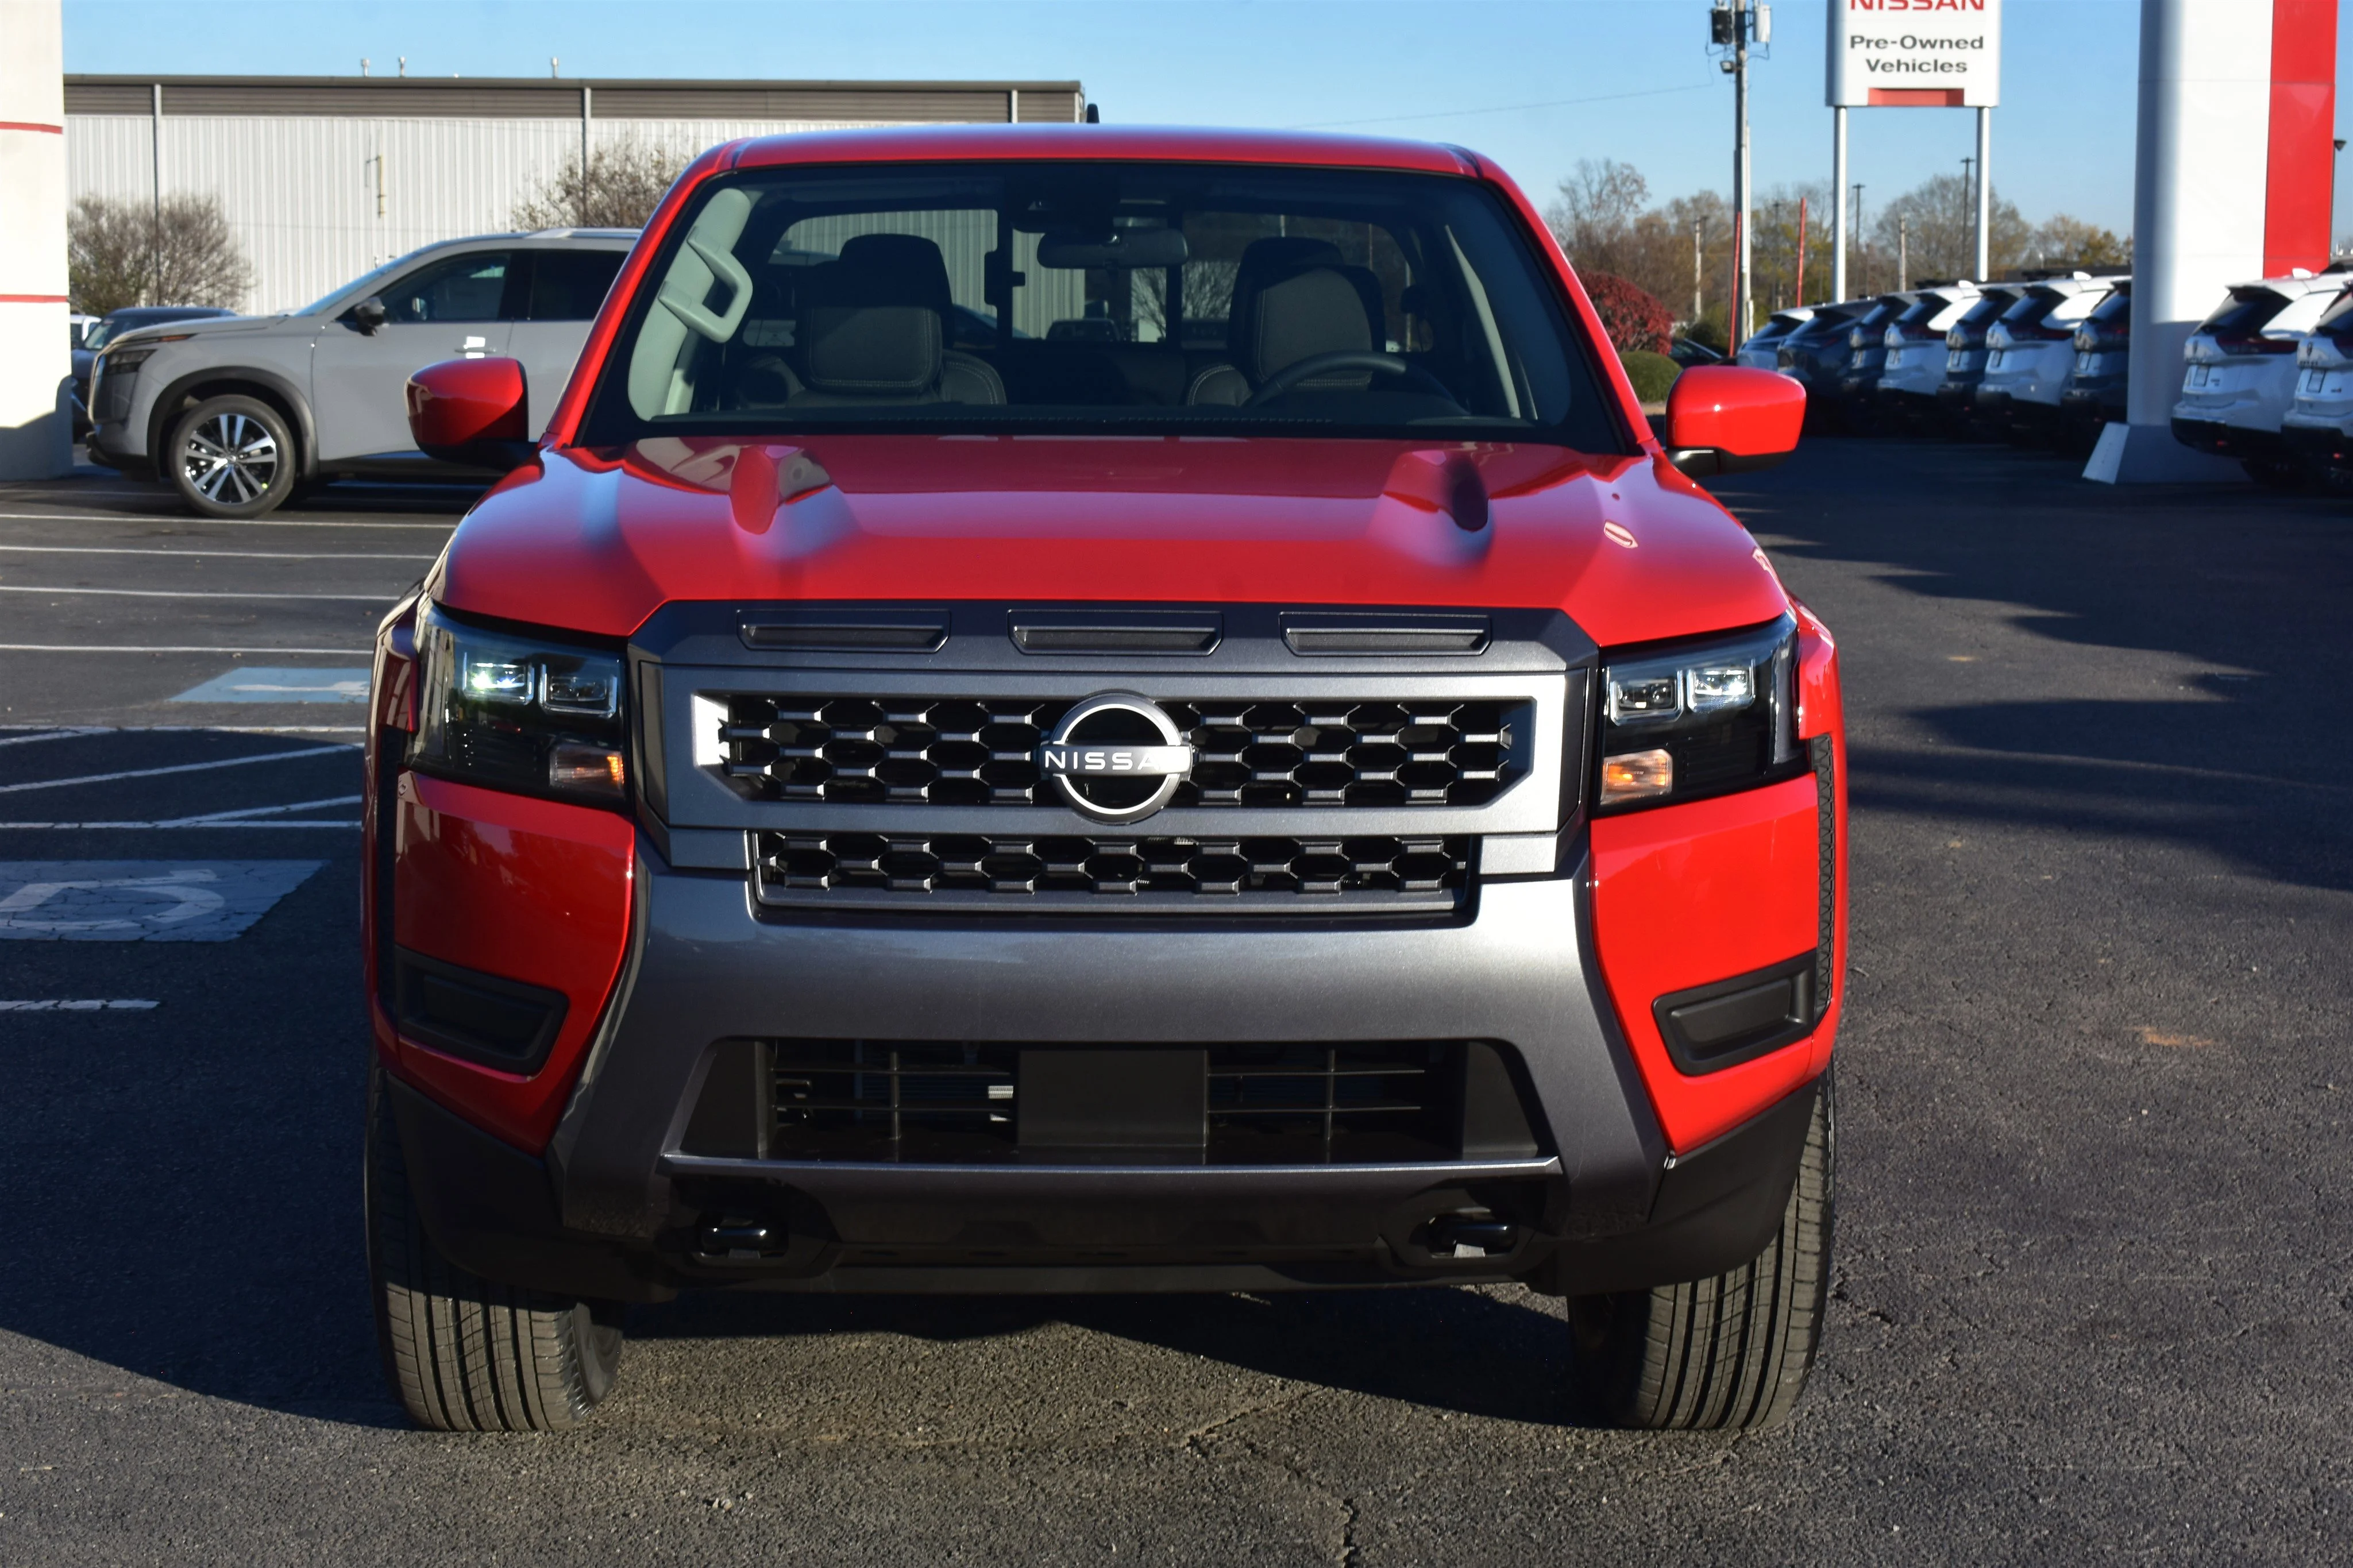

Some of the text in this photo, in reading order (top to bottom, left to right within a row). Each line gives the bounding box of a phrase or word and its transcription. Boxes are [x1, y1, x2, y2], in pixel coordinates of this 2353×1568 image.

[1850, 35, 1984, 49] Pre-Owned
[1866, 59, 1968, 73] Vehicles
[1045, 751, 1162, 770] NISSA
